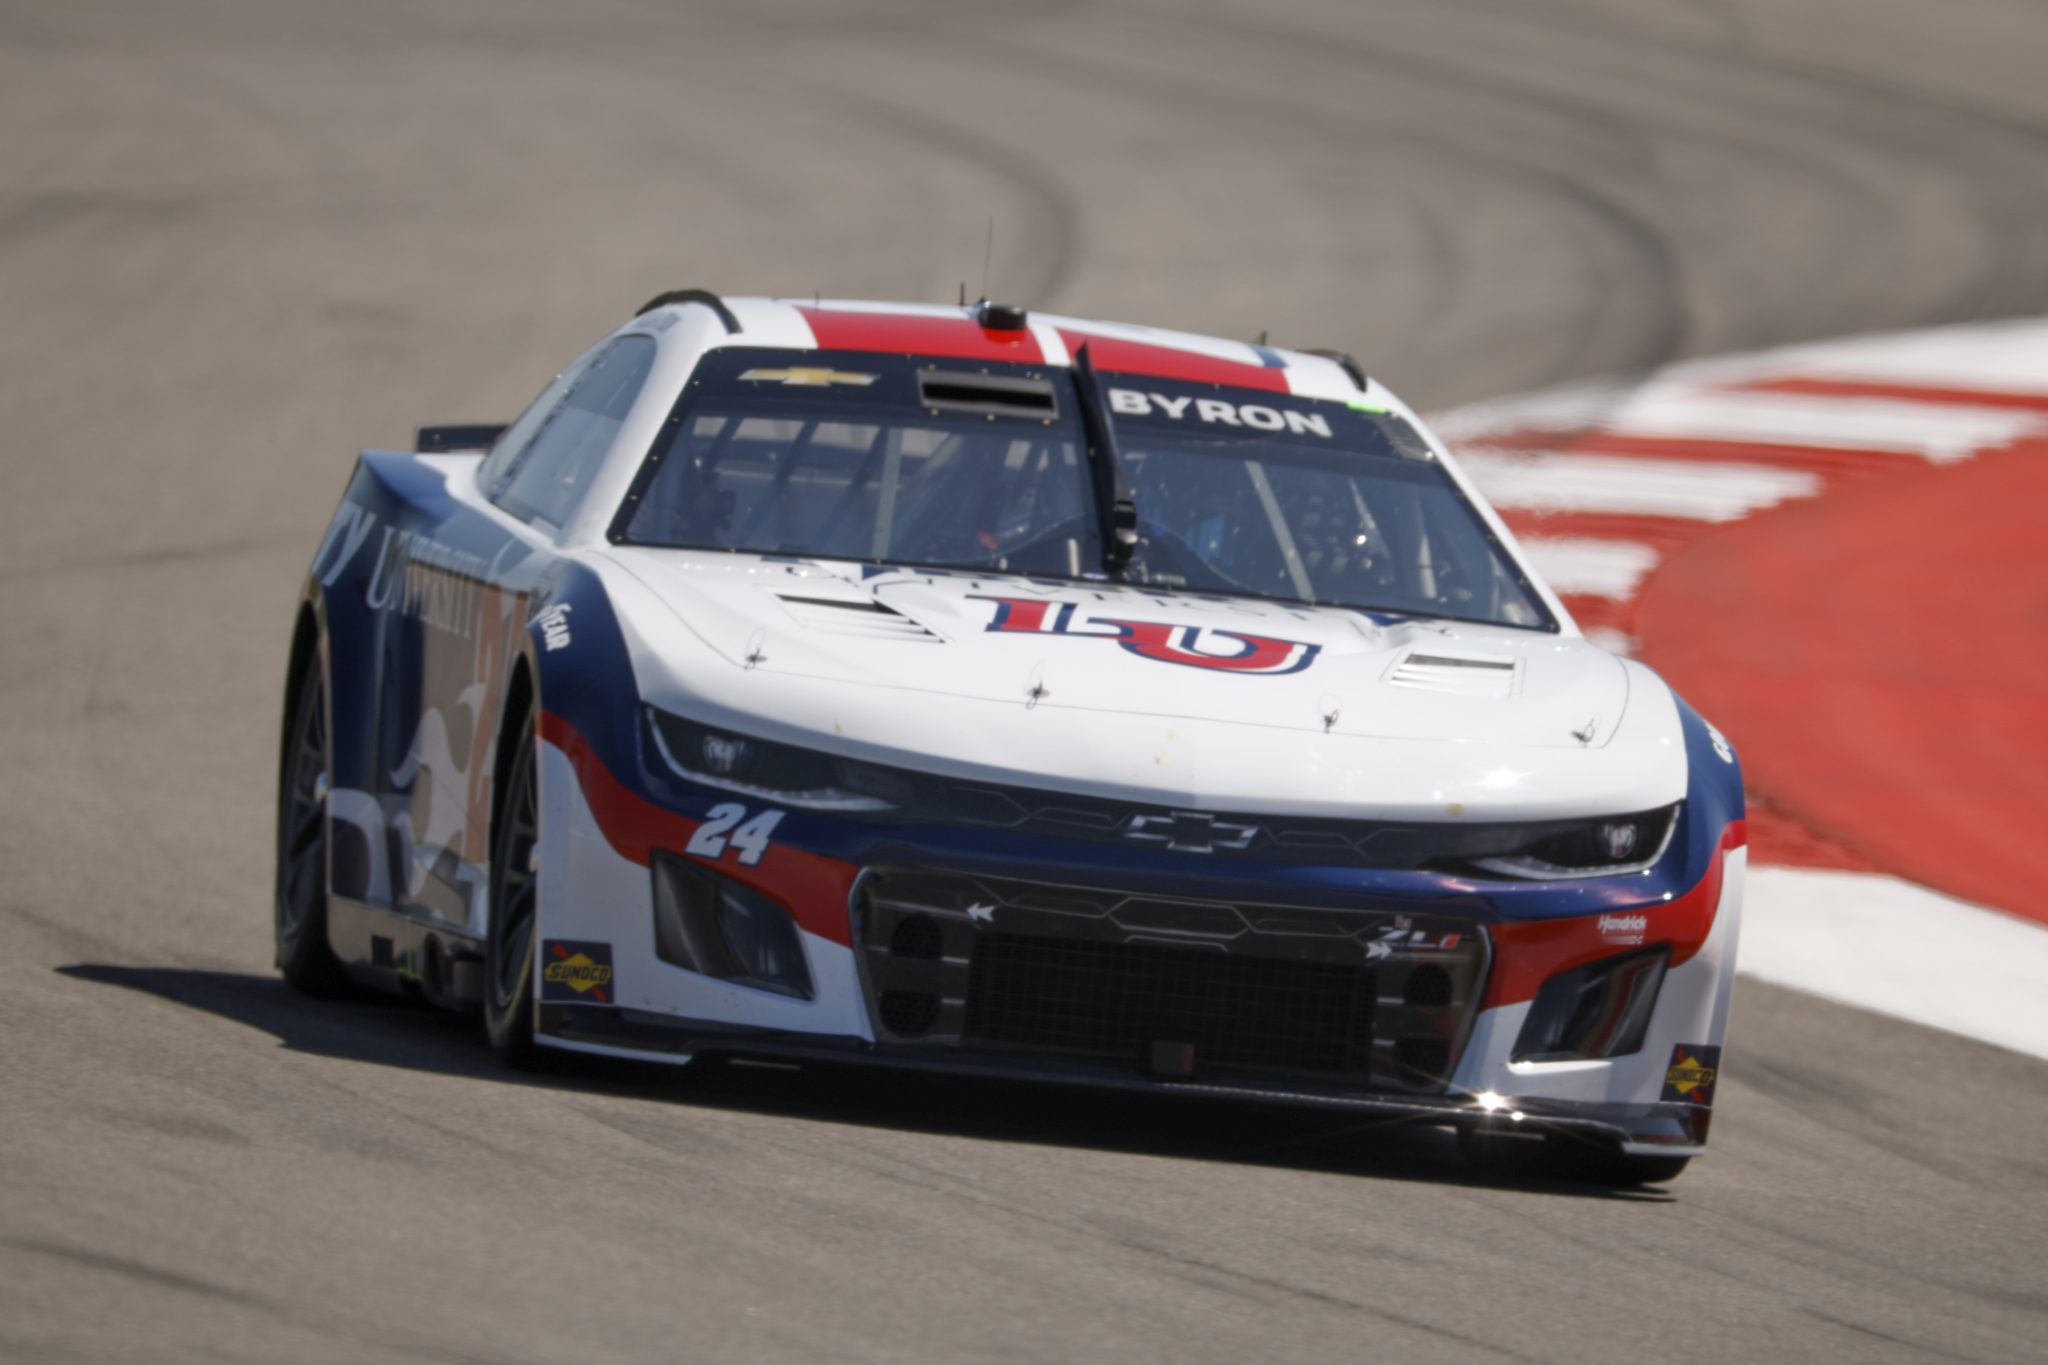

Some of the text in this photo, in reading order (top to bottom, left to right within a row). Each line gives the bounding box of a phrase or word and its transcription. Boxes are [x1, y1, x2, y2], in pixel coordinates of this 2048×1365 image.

[1108, 388, 1334, 438] BYRON
[685, 802, 787, 867] 24
[1597, 914, 1648, 934] Hendrick
[548, 963, 609, 983] SUNOCO
